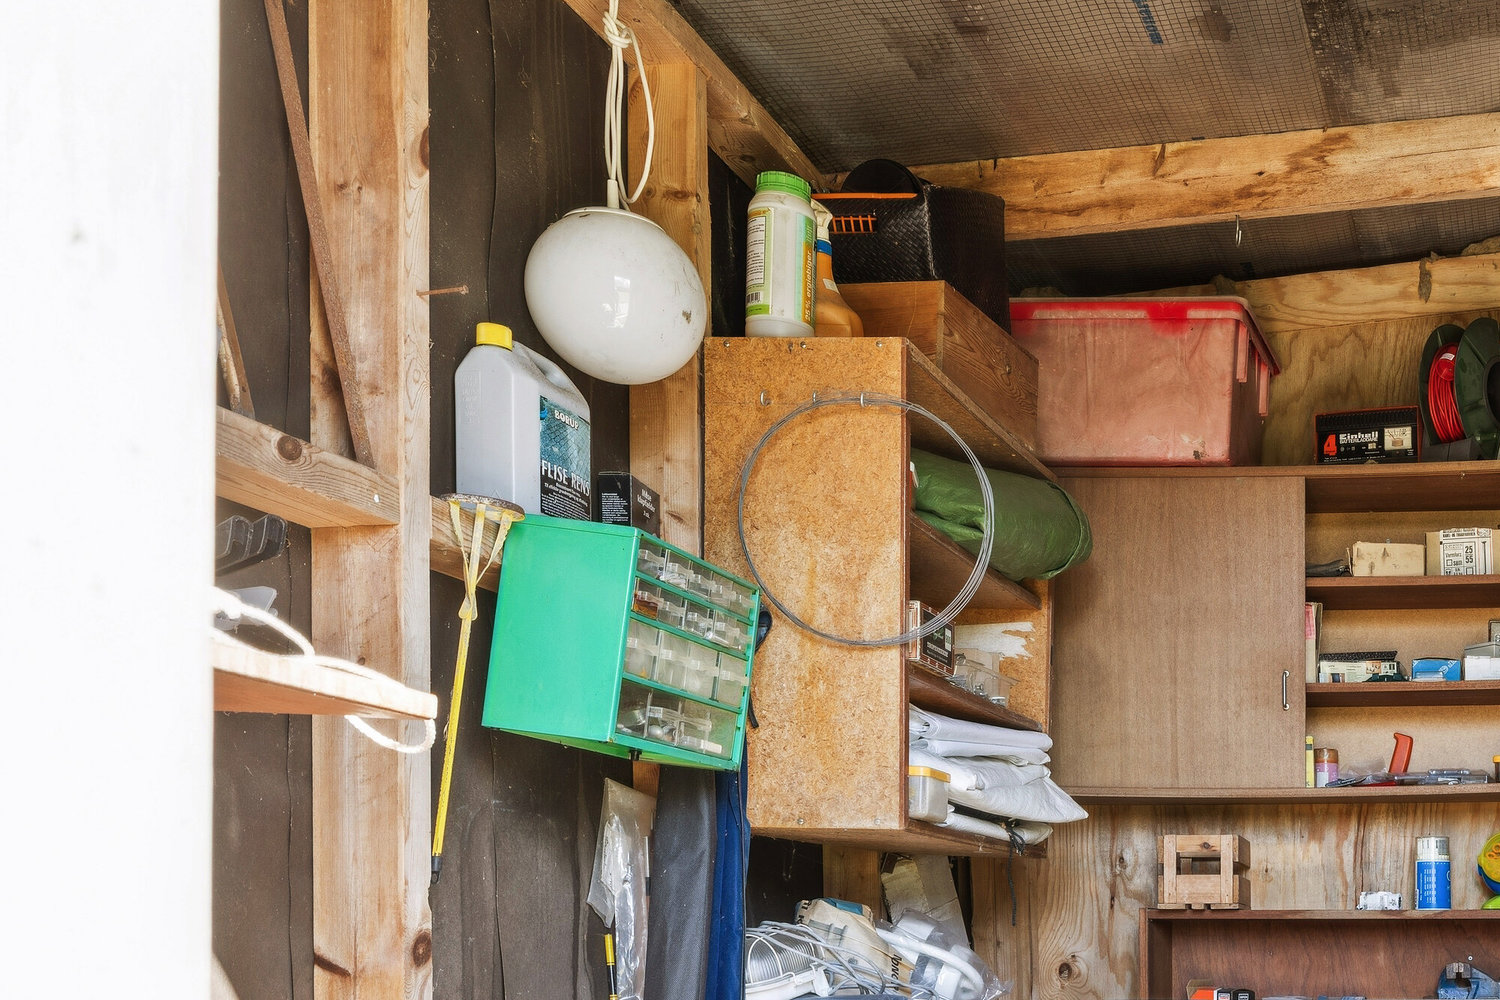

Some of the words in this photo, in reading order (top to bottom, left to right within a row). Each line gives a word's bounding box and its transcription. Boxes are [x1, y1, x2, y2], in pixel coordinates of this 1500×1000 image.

[554, 409, 580, 430] BORUP
[1339, 431, 1378, 440] Einhell
[1323, 434, 1337, 456] 4
[541, 459, 568, 485] FLISE
[571, 472, 590, 496] RENS
[1465, 546, 1473, 554] 25
[1465, 556, 1474, 564] 55
